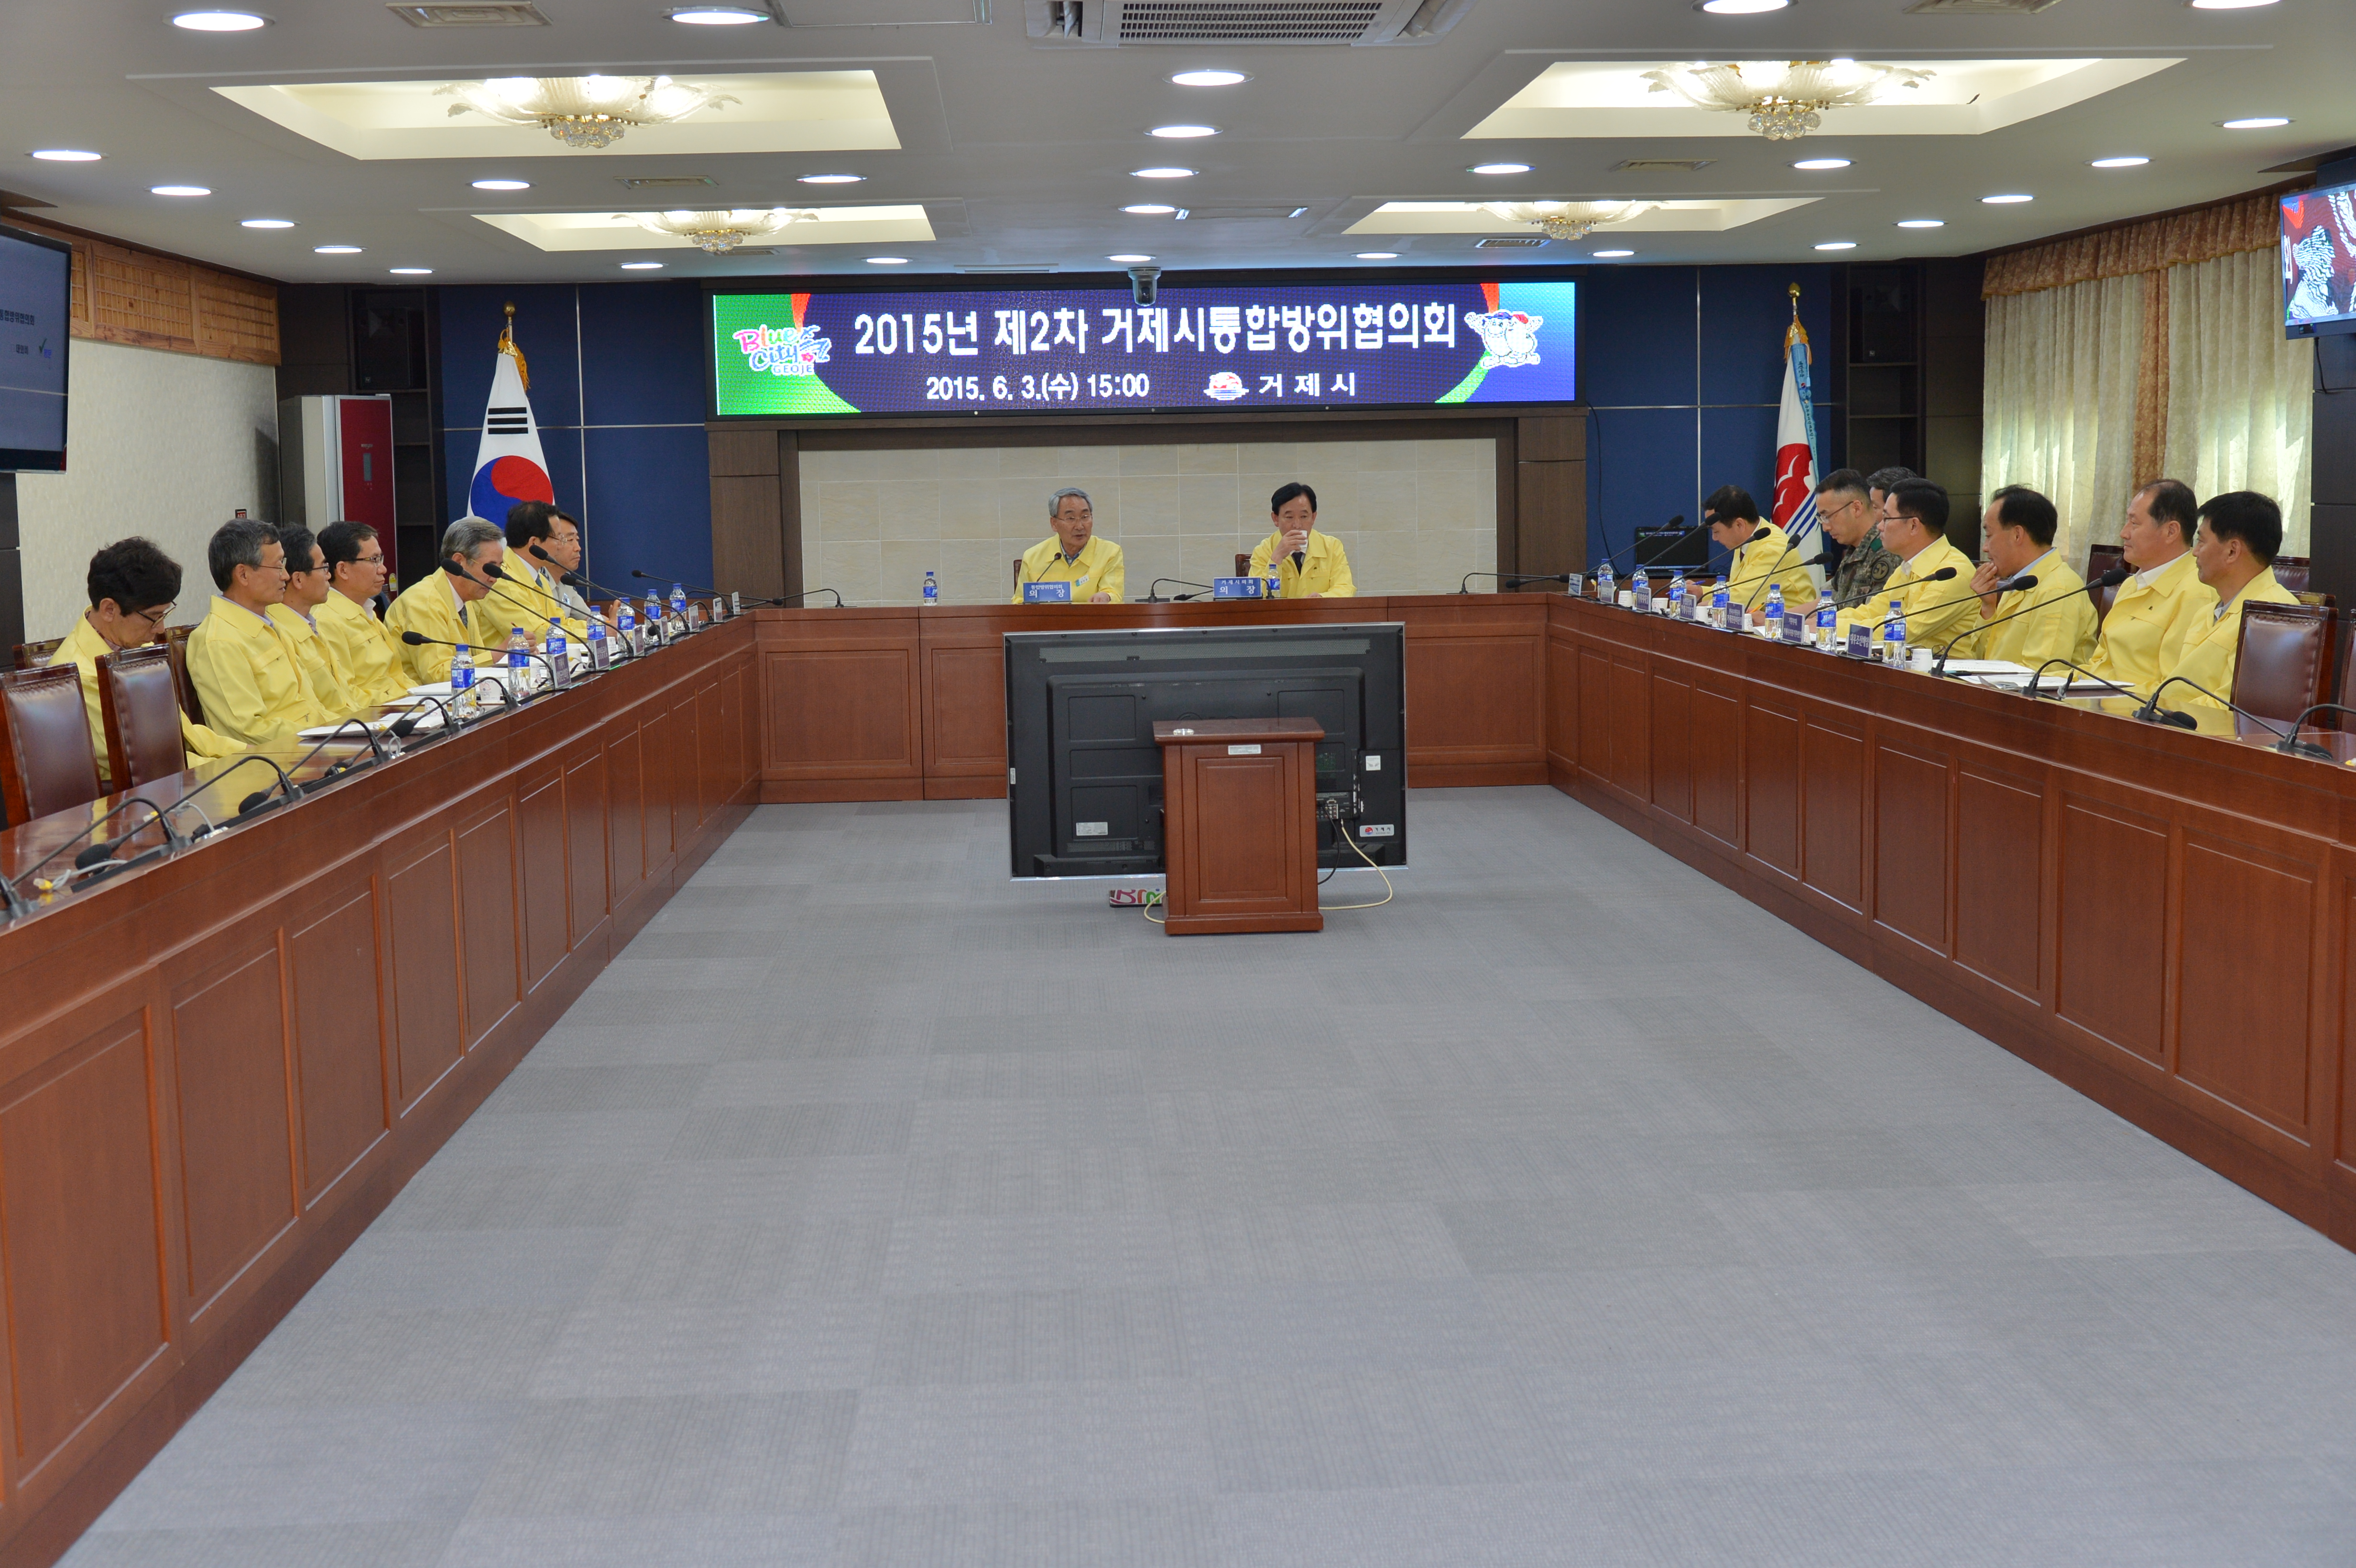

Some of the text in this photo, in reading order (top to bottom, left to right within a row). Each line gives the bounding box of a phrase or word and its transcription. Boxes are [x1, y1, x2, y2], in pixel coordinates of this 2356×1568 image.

[734, 325, 798, 352] Blue
[855, 303, 1455, 356] 2015년 제2차 거제시통합방위협의회
[751, 344, 798, 370] City
[773, 364, 813, 375] GEOJE
[926, 376, 985, 401] 2015.
[993, 375, 1013, 401] 6.
[1087, 373, 1150, 398] 15:00
